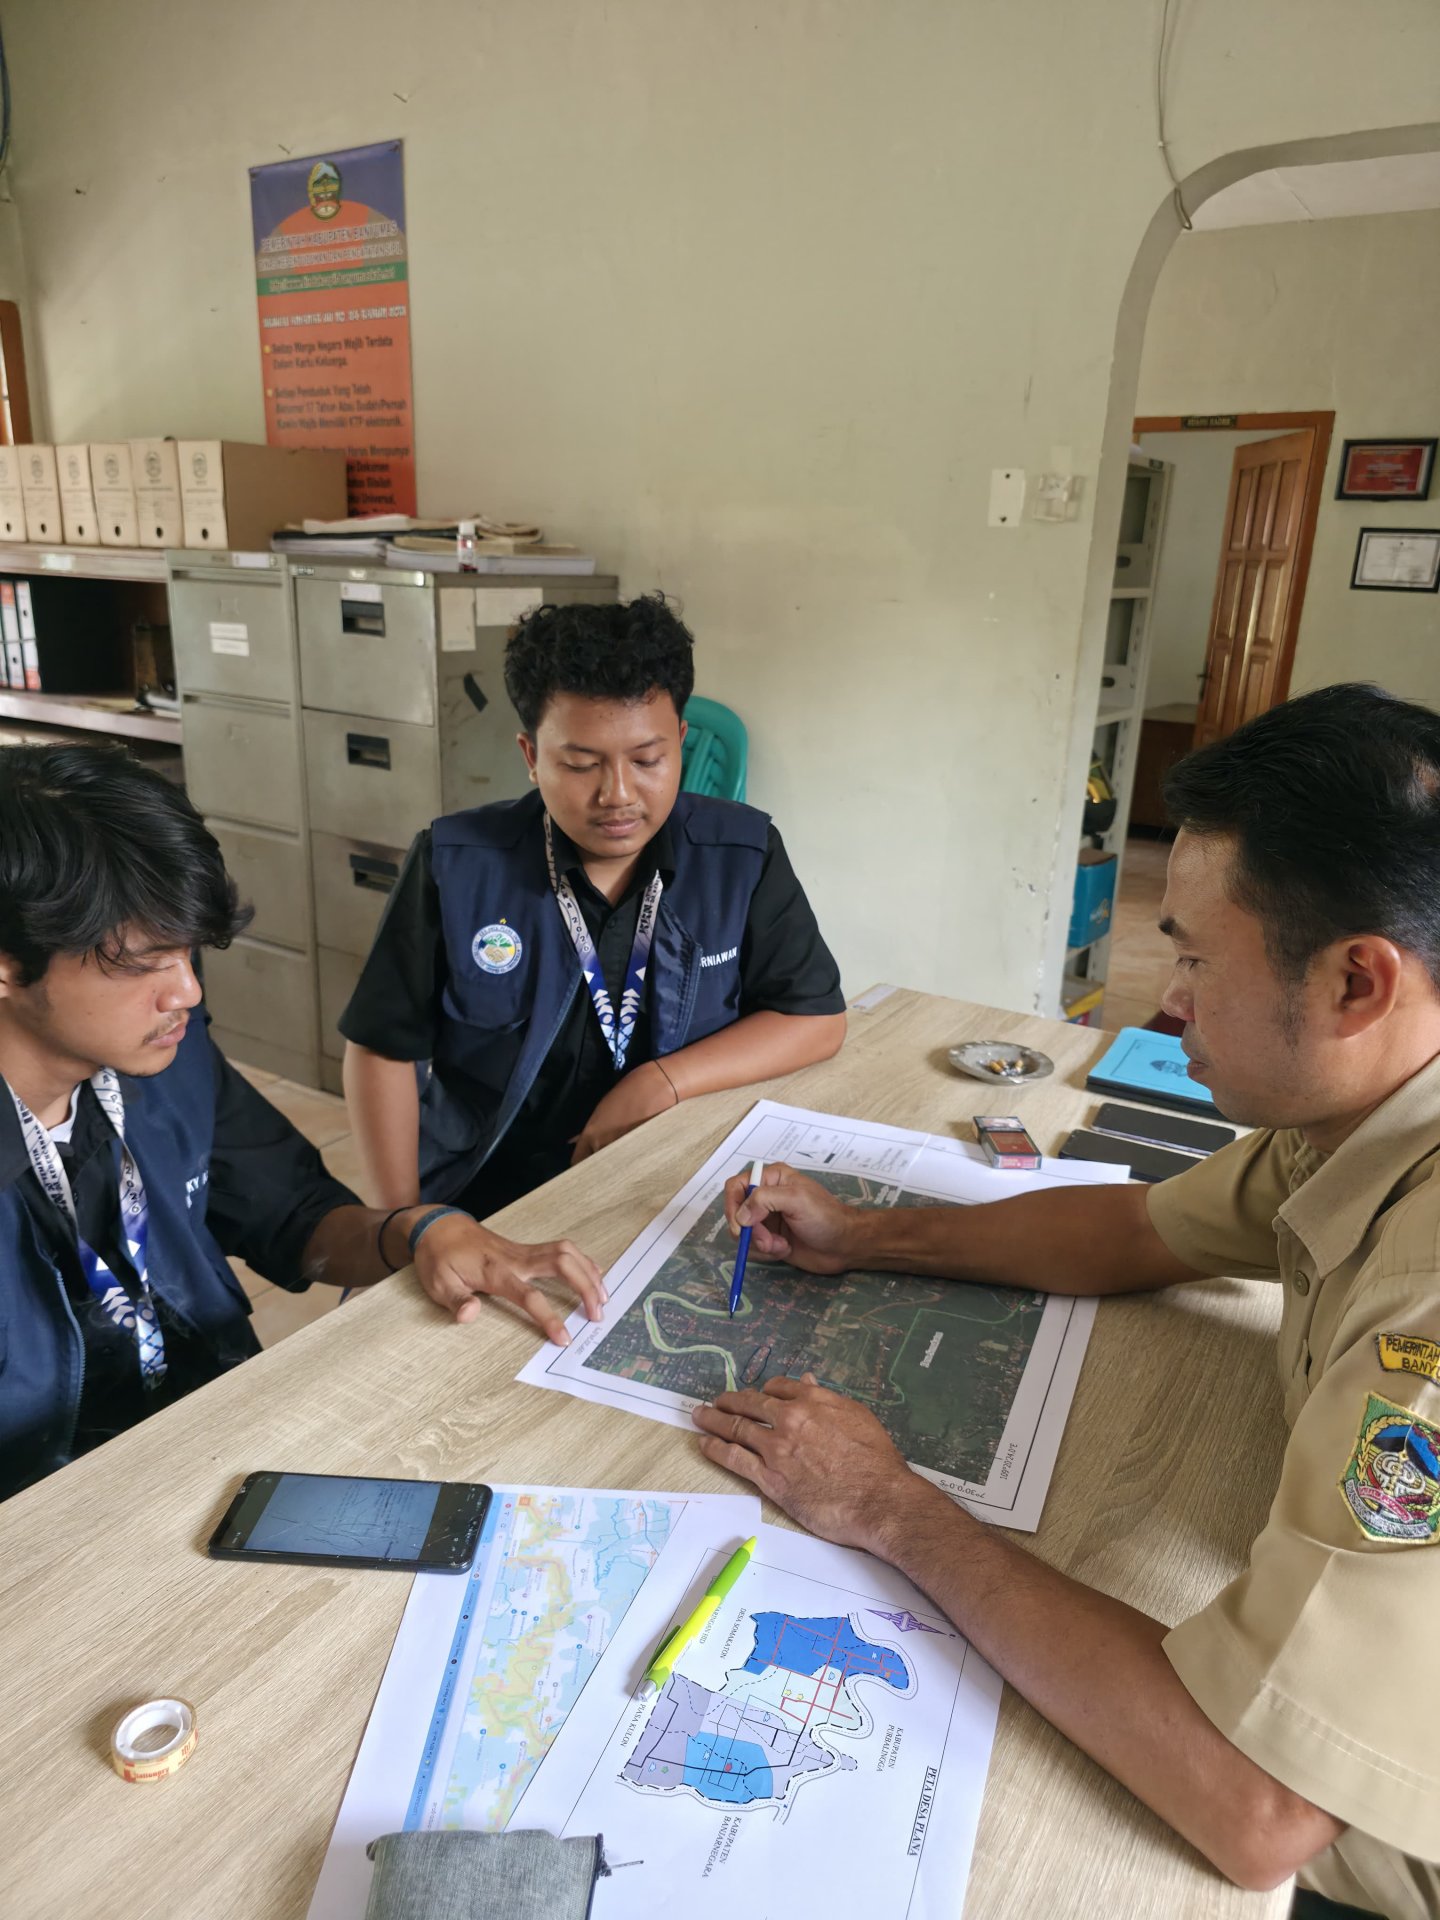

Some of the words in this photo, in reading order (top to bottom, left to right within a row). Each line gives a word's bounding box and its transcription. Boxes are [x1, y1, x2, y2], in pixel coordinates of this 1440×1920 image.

[700, 946, 738, 968] RNIAWAN
[124, 1166, 141, 1215] 2026
[1385, 1335, 1440, 1364] PEMERINTAH
[736, 1607, 748, 1622] DESA
[720, 1622, 740, 1659] SOMAKATON
[631, 1703, 647, 1722] PIASA
[620, 1722, 637, 1747] KULON
[876, 1724, 895, 1772] PURBALINGGA
[887, 1727, 904, 1769] KABUPATEN
[923, 1766, 938, 1792] PETA
[917, 1793, 932, 1820] DESA
[701, 1815, 732, 1878] BANJARNEGARA
[719, 1816, 742, 1865] KABUPATEN
[908, 1821, 925, 1857] PLANA
